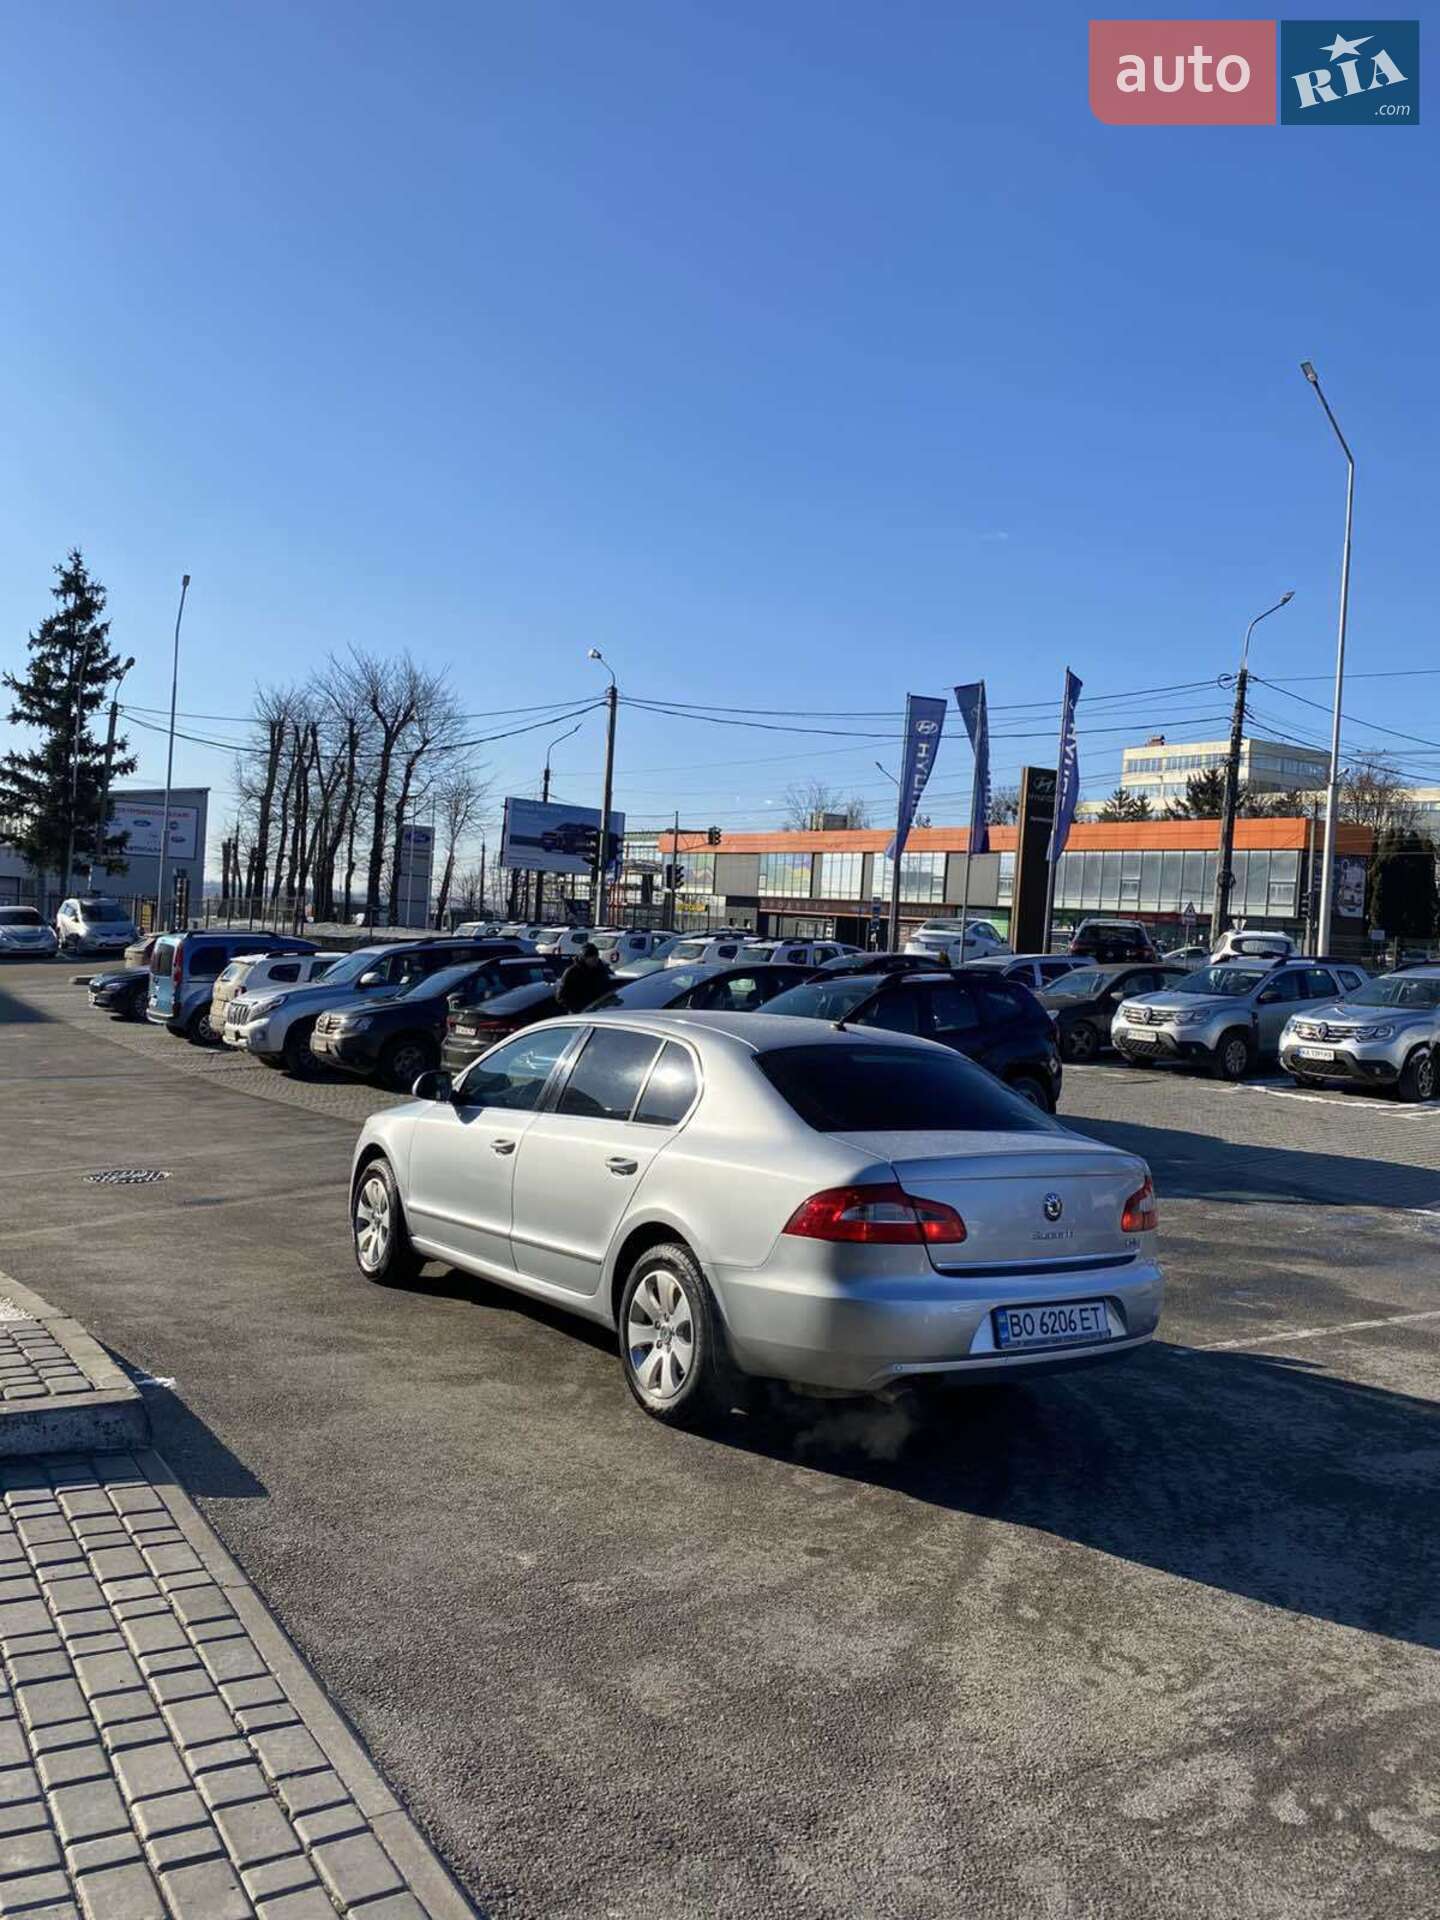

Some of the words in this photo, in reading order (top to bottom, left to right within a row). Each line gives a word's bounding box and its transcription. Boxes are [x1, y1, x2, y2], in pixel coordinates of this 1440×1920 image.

[1009, 1313, 1035, 1337] BO
[1040, 1309, 1077, 1335] 6206
[1079, 1306, 1100, 1331] ET
